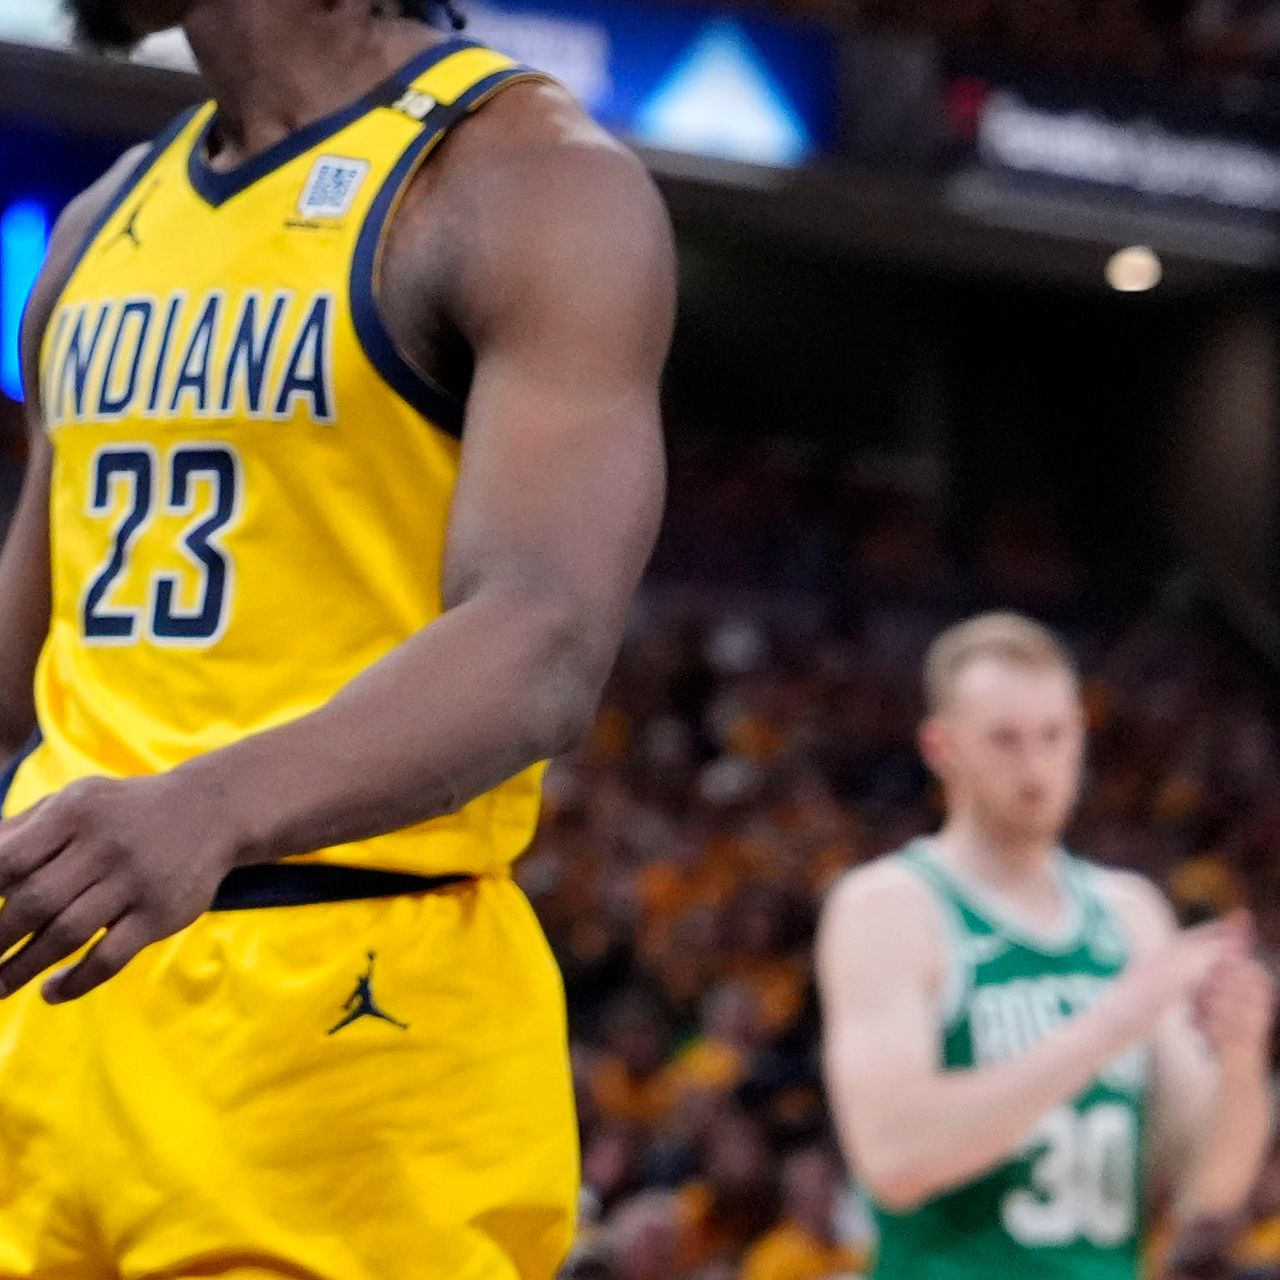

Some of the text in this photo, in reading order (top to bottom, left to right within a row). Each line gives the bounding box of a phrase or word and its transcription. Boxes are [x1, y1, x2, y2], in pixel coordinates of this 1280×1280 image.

[46, 288, 337, 430] INDIANA
[83, 442, 245, 648] 23
[1002, 1104, 1140, 1248] 30
